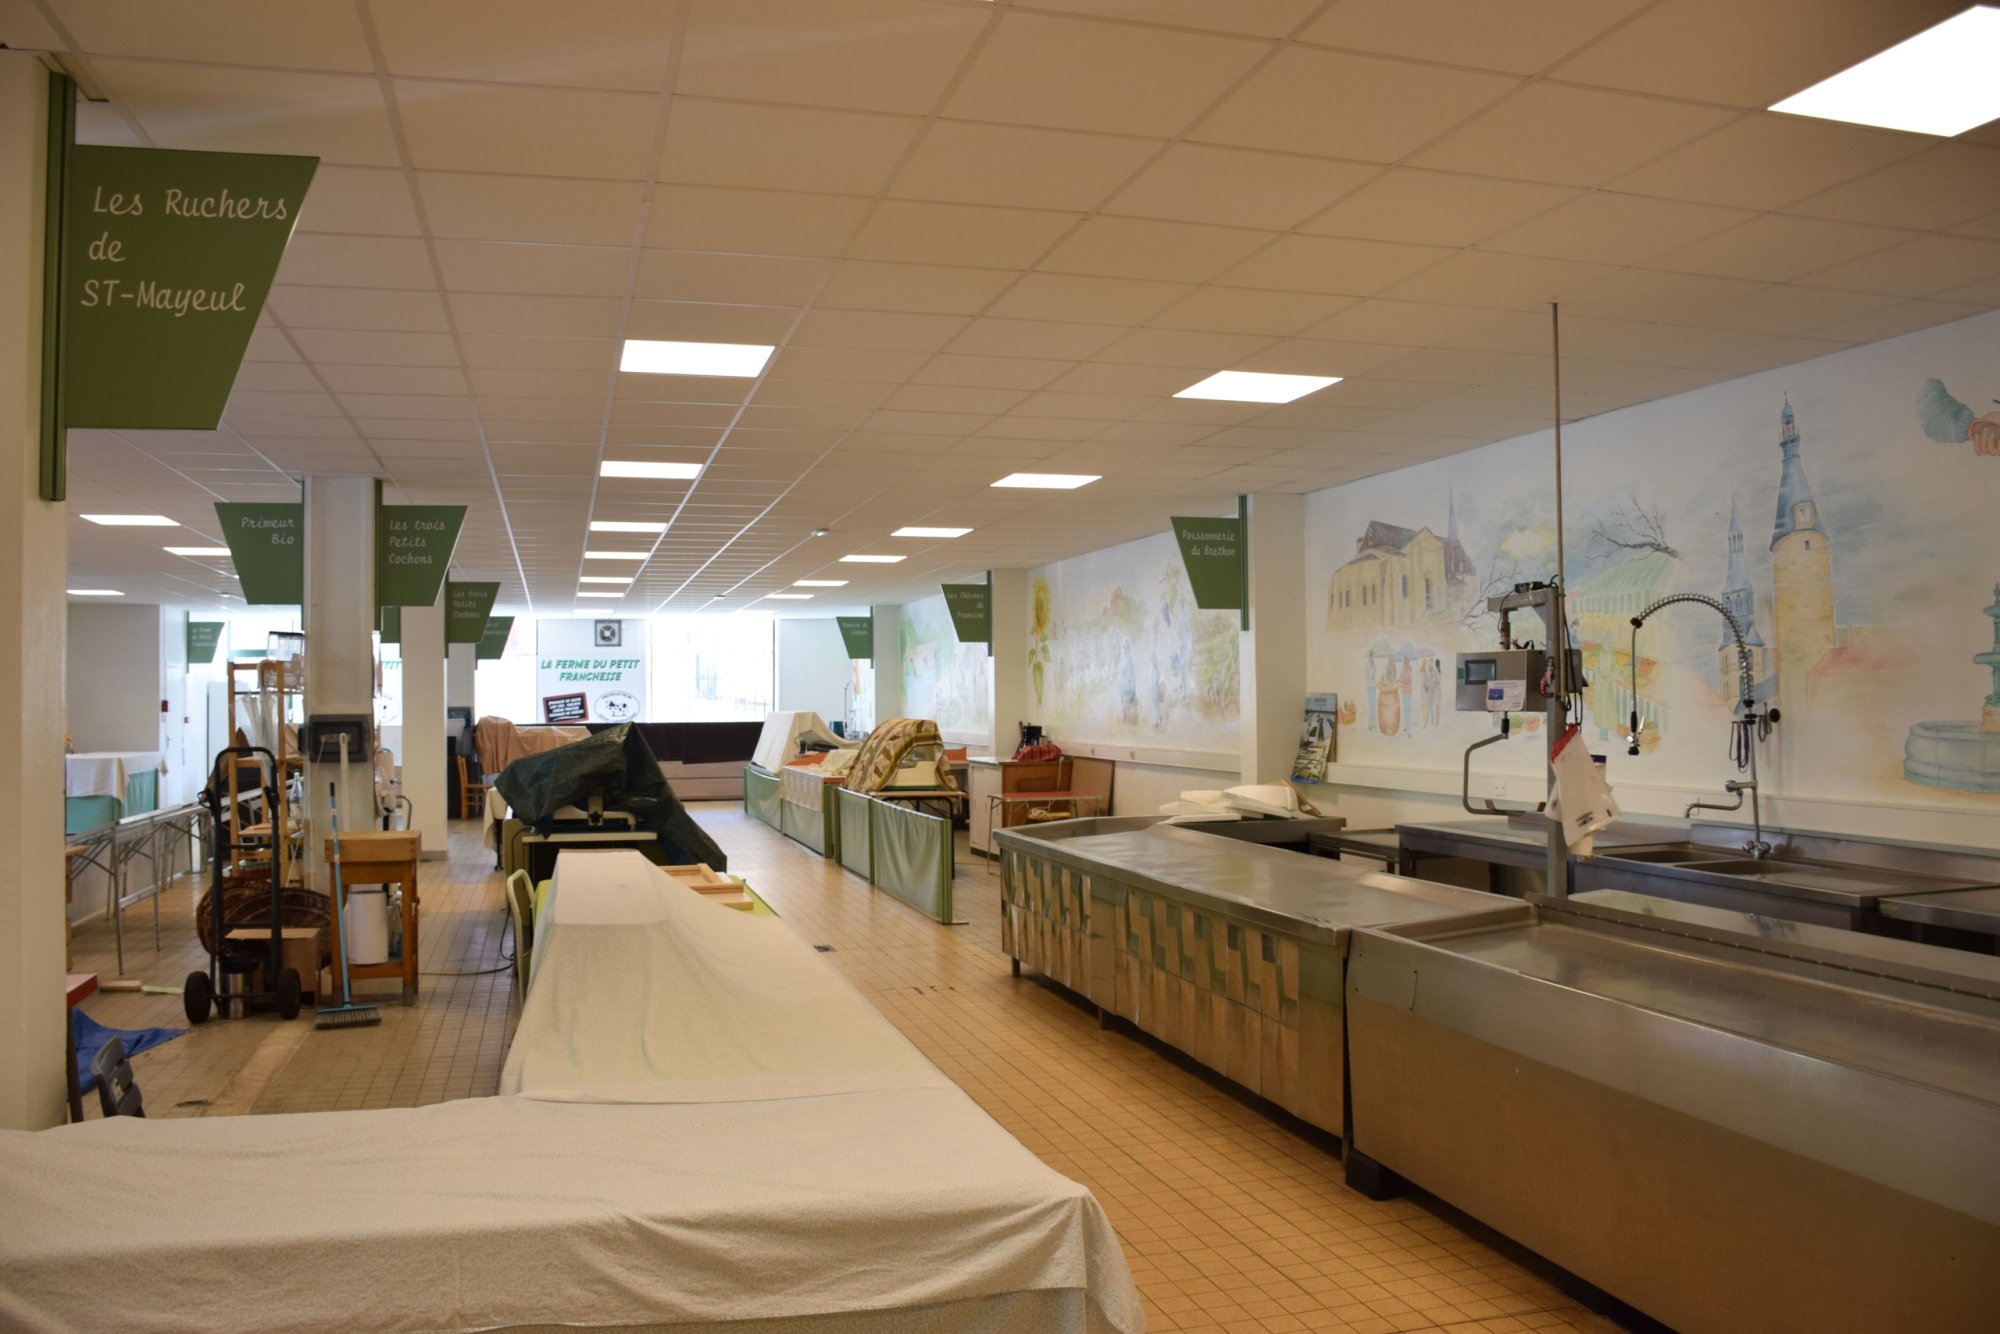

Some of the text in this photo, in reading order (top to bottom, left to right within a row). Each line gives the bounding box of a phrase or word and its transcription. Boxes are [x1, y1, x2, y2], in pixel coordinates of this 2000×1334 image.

[92, 186, 288, 220] Les Ruchers
[88, 231, 127, 262] de
[80, 279, 247, 317] ST-Mayeul
[241, 516, 295, 529] Primeur
[389, 520, 445, 531] Les trois
[271, 533, 295, 545] Bio
[388, 536, 427, 547] Petits
[1182, 529, 1236, 542] Poissonnerie
[1191, 545, 1201, 556] du
[388, 552, 433, 565] Cochons
[541, 659, 640, 669] LA FERME DU PETIT
[559, 671, 622, 682] FRANCHESSE
